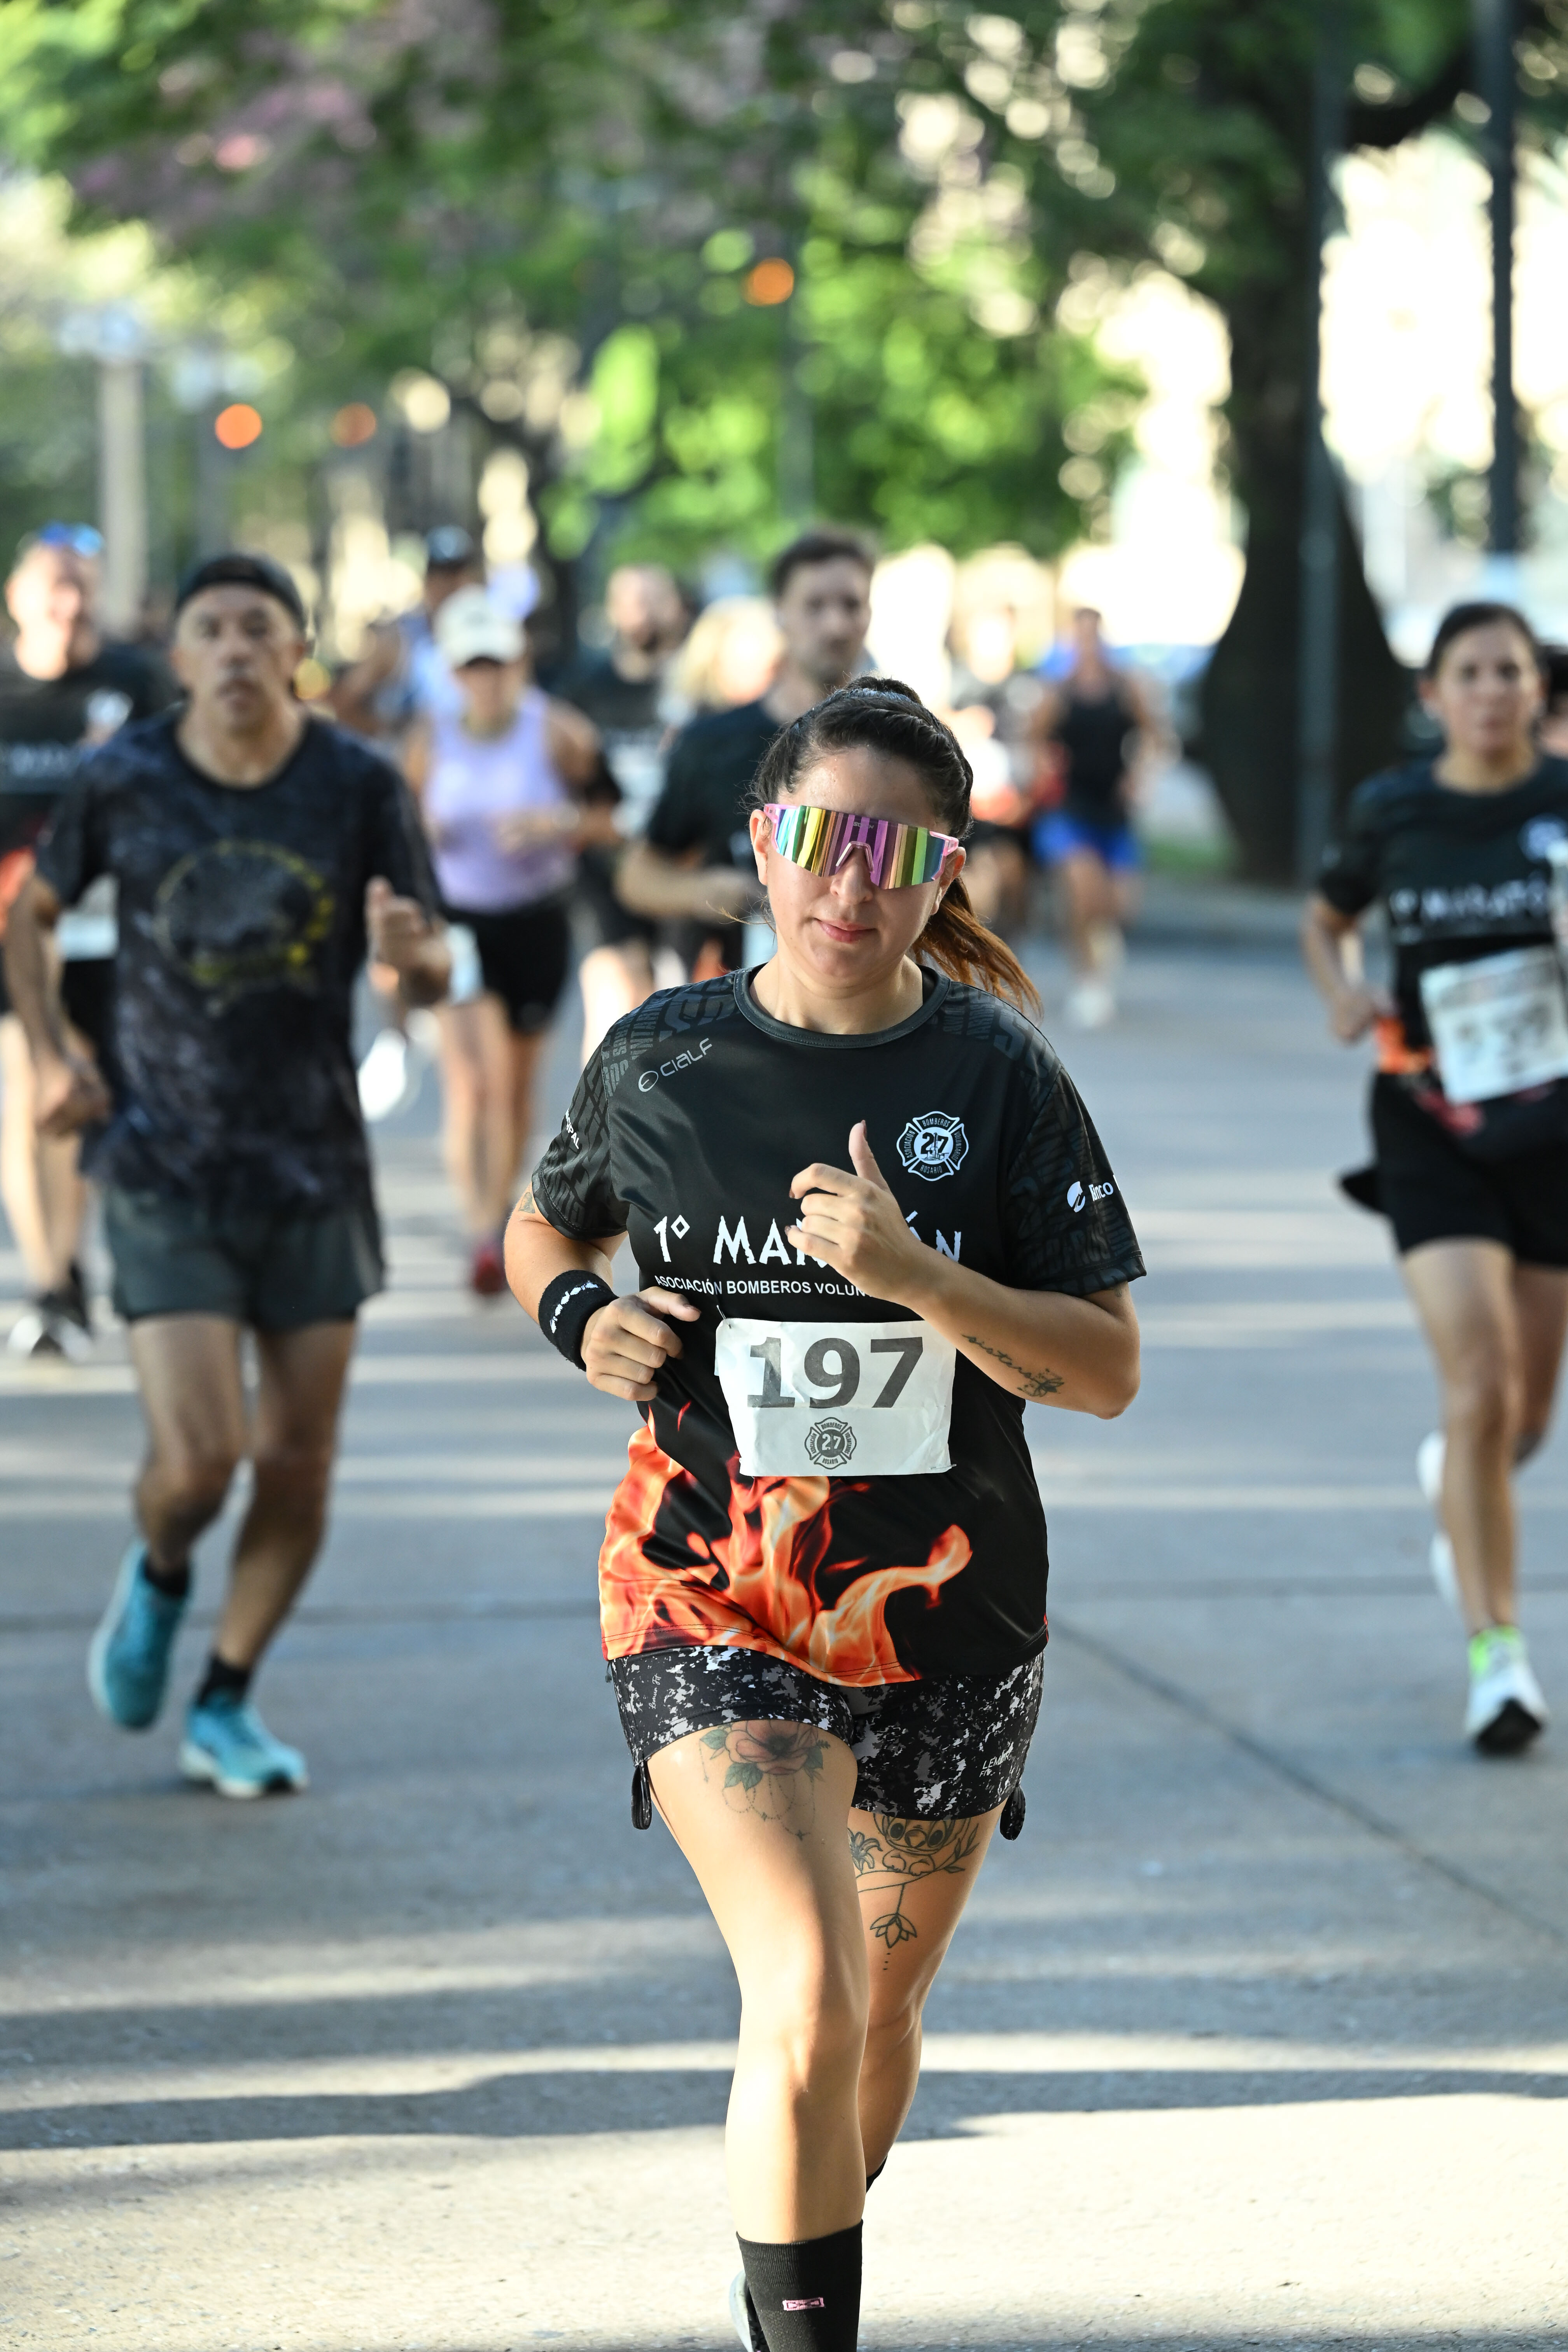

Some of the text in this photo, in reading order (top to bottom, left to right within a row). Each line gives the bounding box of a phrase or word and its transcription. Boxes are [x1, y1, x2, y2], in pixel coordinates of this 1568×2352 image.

[922, 1118, 951, 1128] BOMBEROS
[903, 1130, 915, 1158] ASOCIACIÓN
[920, 1132, 949, 1155] 27
[920, 1165, 942, 1174] ROSARIO
[654, 1275, 722, 1295] ASOCIACIÓN
[727, 1280, 811, 1294] BOMBEROS
[747, 1337, 923, 1408] 197
[821, 1422, 842, 1430] BOMBEROS
[822, 1433, 841, 1451] 27
[982, 1752, 1010, 1769] LEMUR
